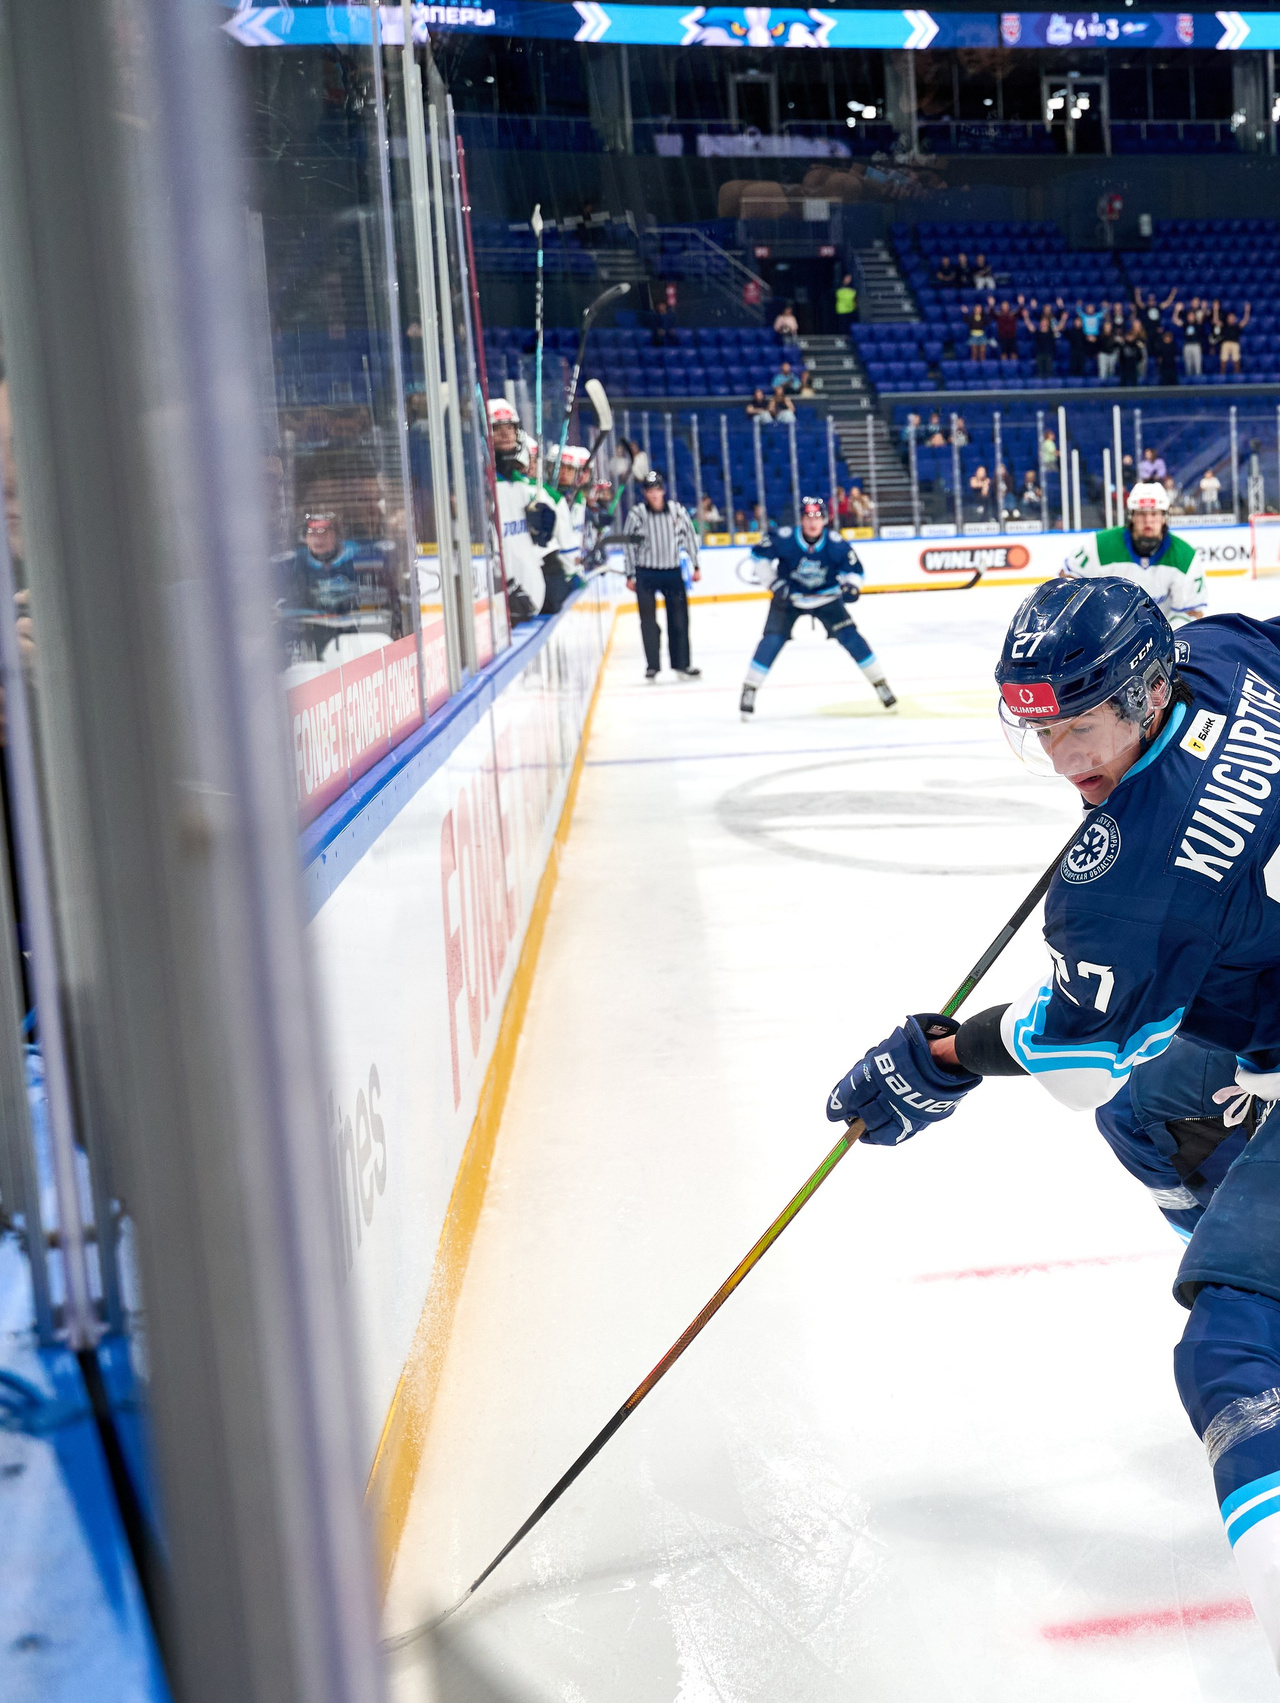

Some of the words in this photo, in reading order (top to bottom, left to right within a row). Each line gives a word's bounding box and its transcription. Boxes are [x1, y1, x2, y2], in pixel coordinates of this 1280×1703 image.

[1073, 18, 1087, 41] 4
[1105, 18, 1120, 41] 3
[924, 548, 1008, 571] WINLINE
[1011, 631, 1048, 660] 27
[1129, 638, 1154, 670] CCM
[387, 651, 419, 730] FONBET
[346, 669, 386, 760] FONBET
[1010, 705, 1054, 715] OLIMPBET
[294, 691, 344, 796] FONBET
[1198, 717, 1216, 742] БАНК
[1089, 854, 1114, 878] ОБЛАСТЬ
[328, 1063, 387, 1288] ines
